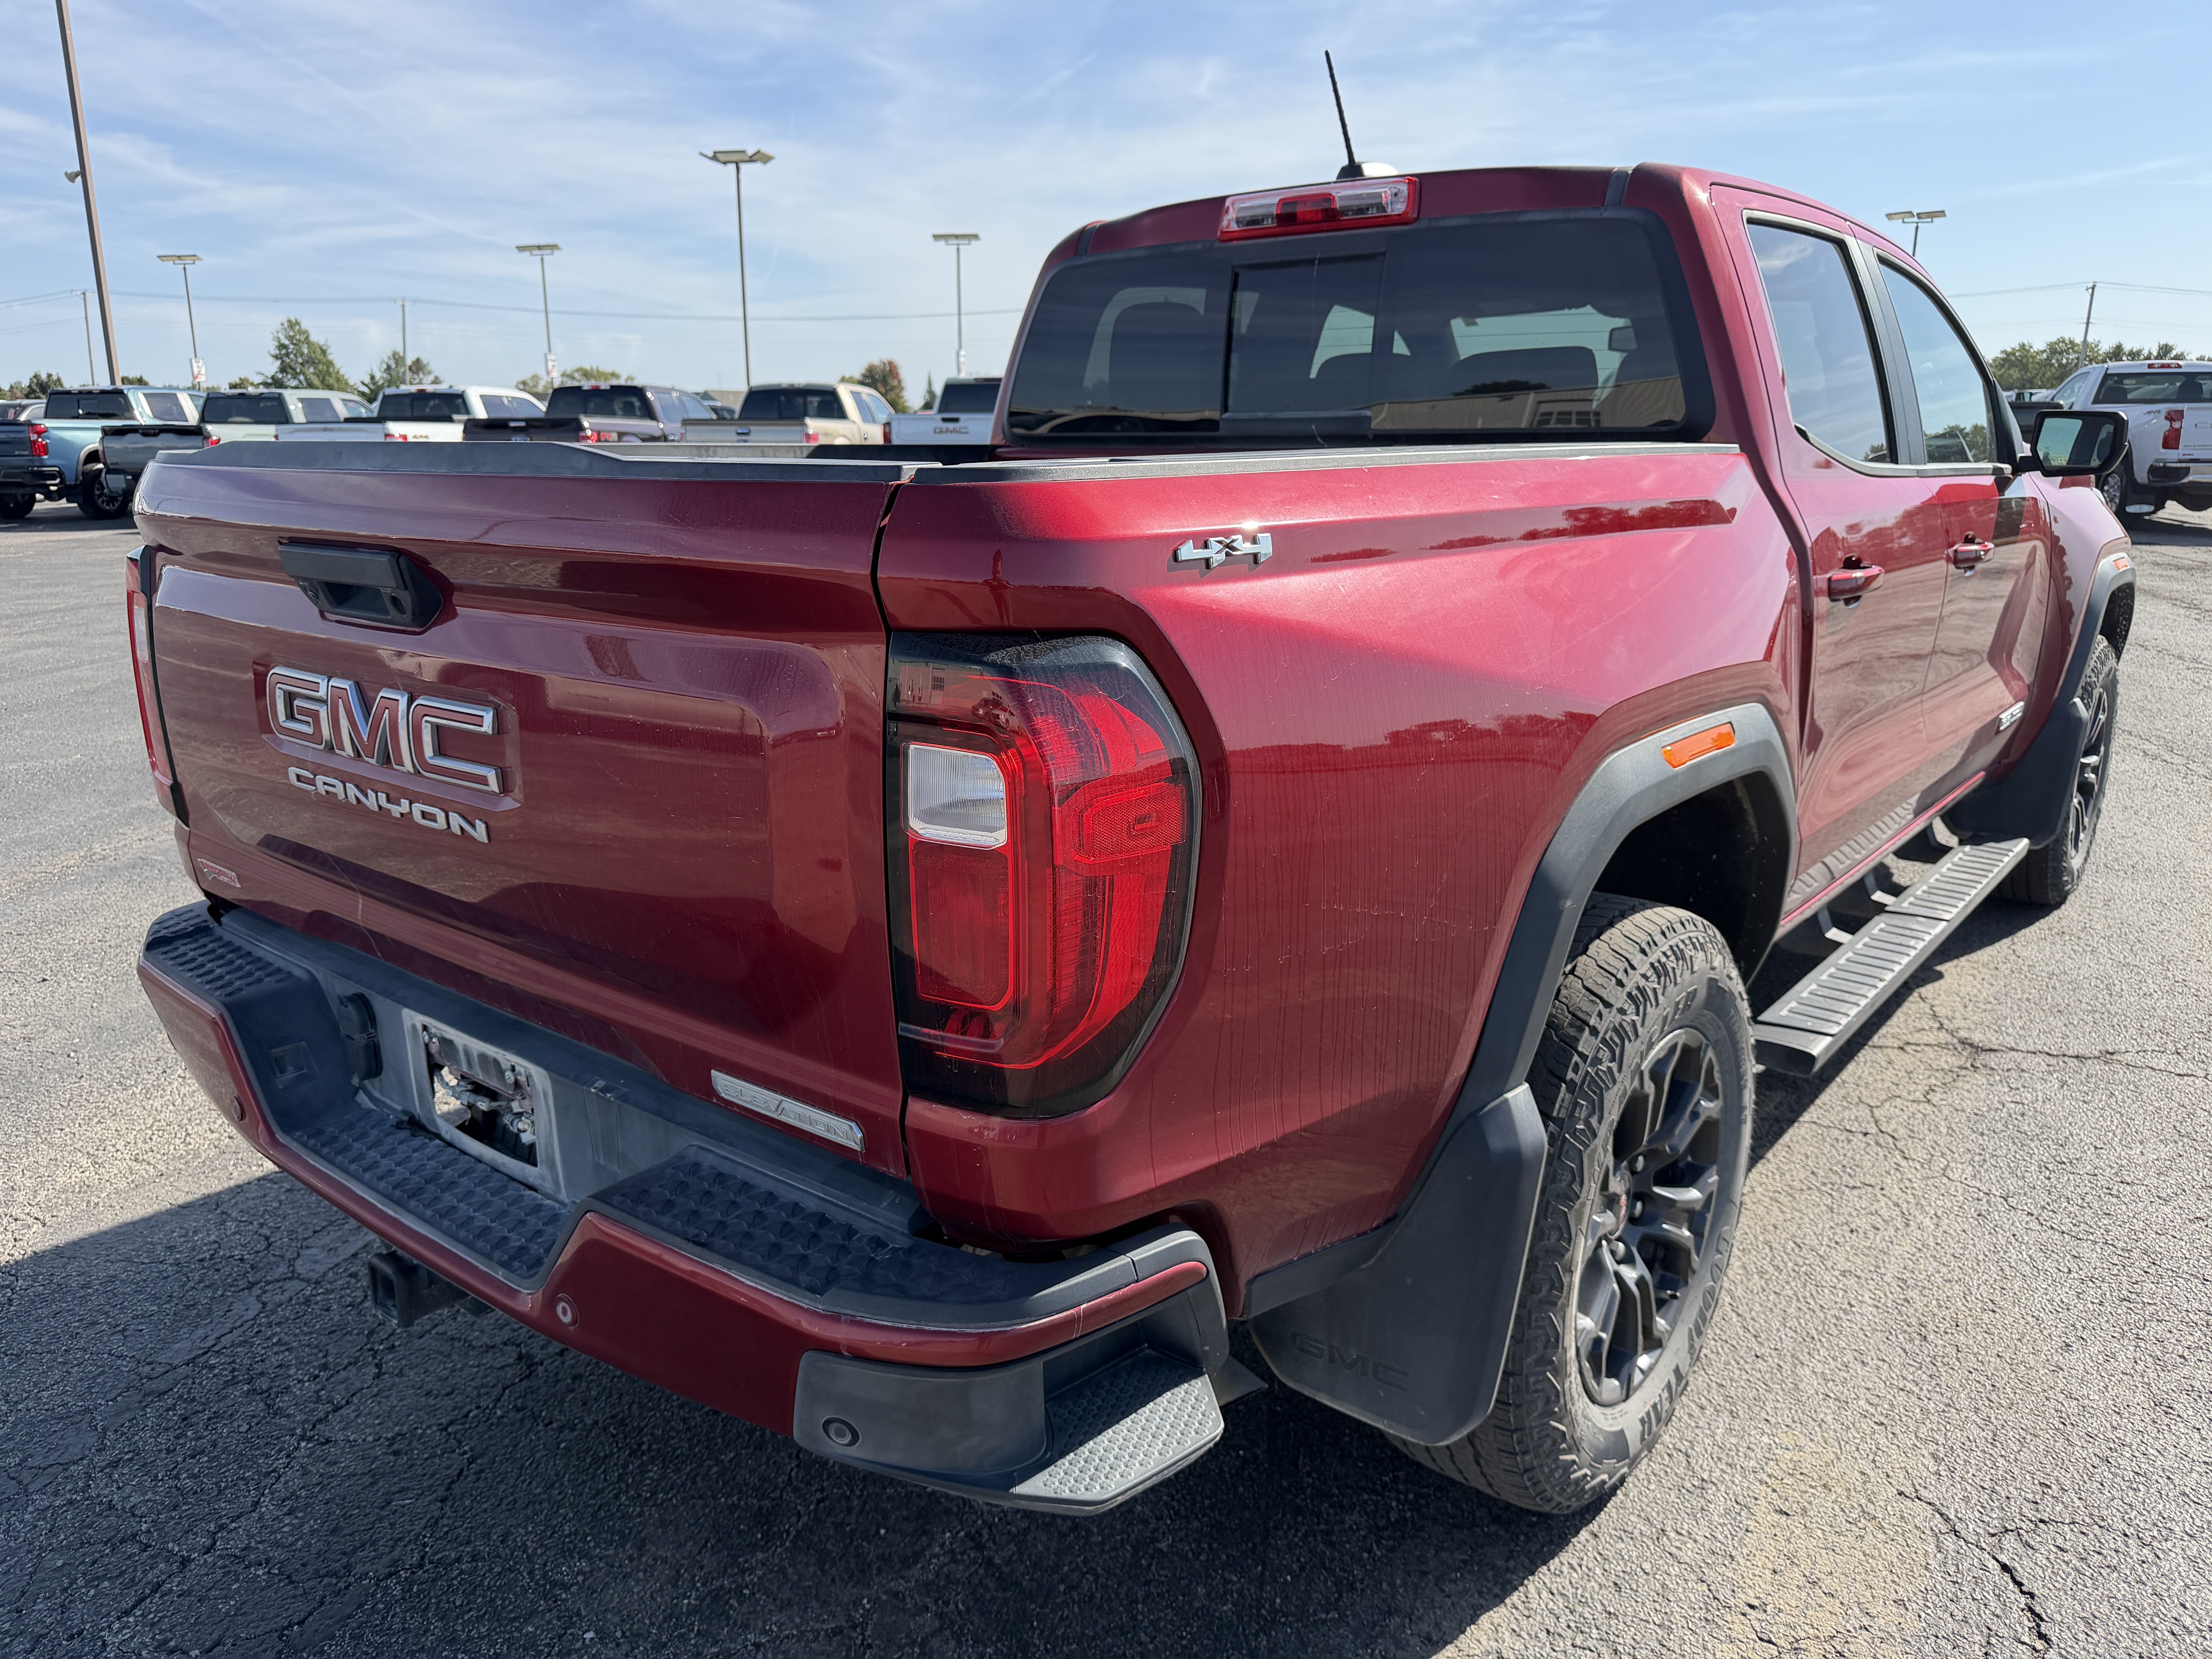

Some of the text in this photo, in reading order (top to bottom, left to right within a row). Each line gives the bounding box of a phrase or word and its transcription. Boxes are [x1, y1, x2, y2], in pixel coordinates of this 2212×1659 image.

[266, 666, 505, 797] GMC
[288, 766, 490, 843] CANYON
[725, 1082, 847, 1139] ELEVATION
[1289, 1330, 1410, 1393] GMC
